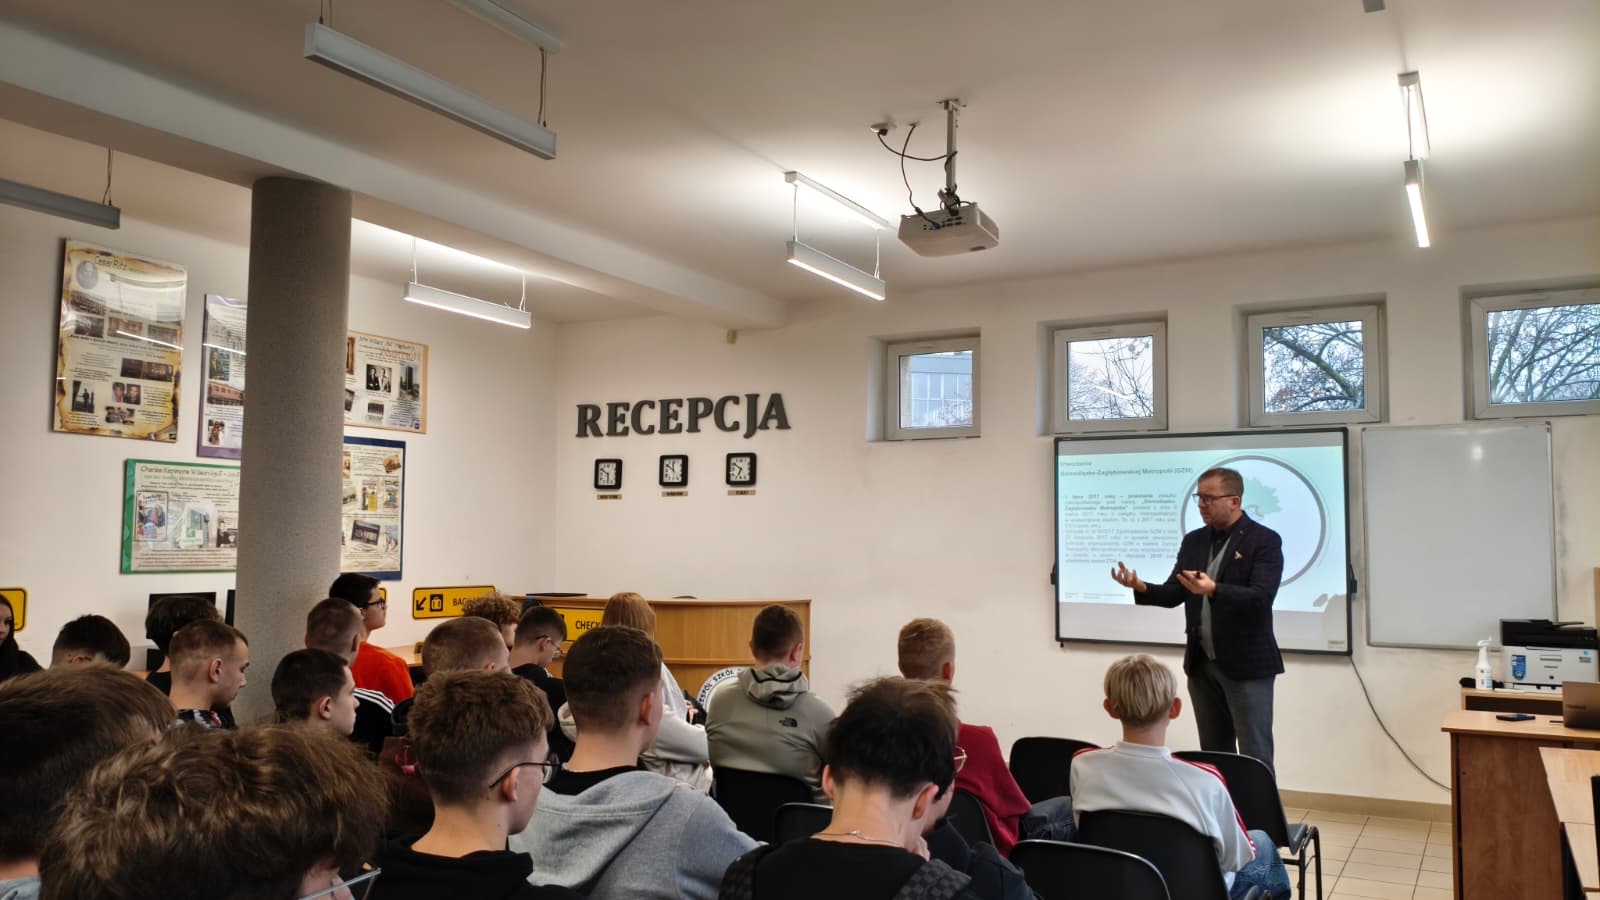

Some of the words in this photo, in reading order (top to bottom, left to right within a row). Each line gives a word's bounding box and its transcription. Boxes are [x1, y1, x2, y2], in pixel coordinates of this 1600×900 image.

[576, 393, 791, 439] RECEPCJA
[698, 682, 713, 703] ESPÓŁ
[713, 669, 735, 682] SZKÓŁ
